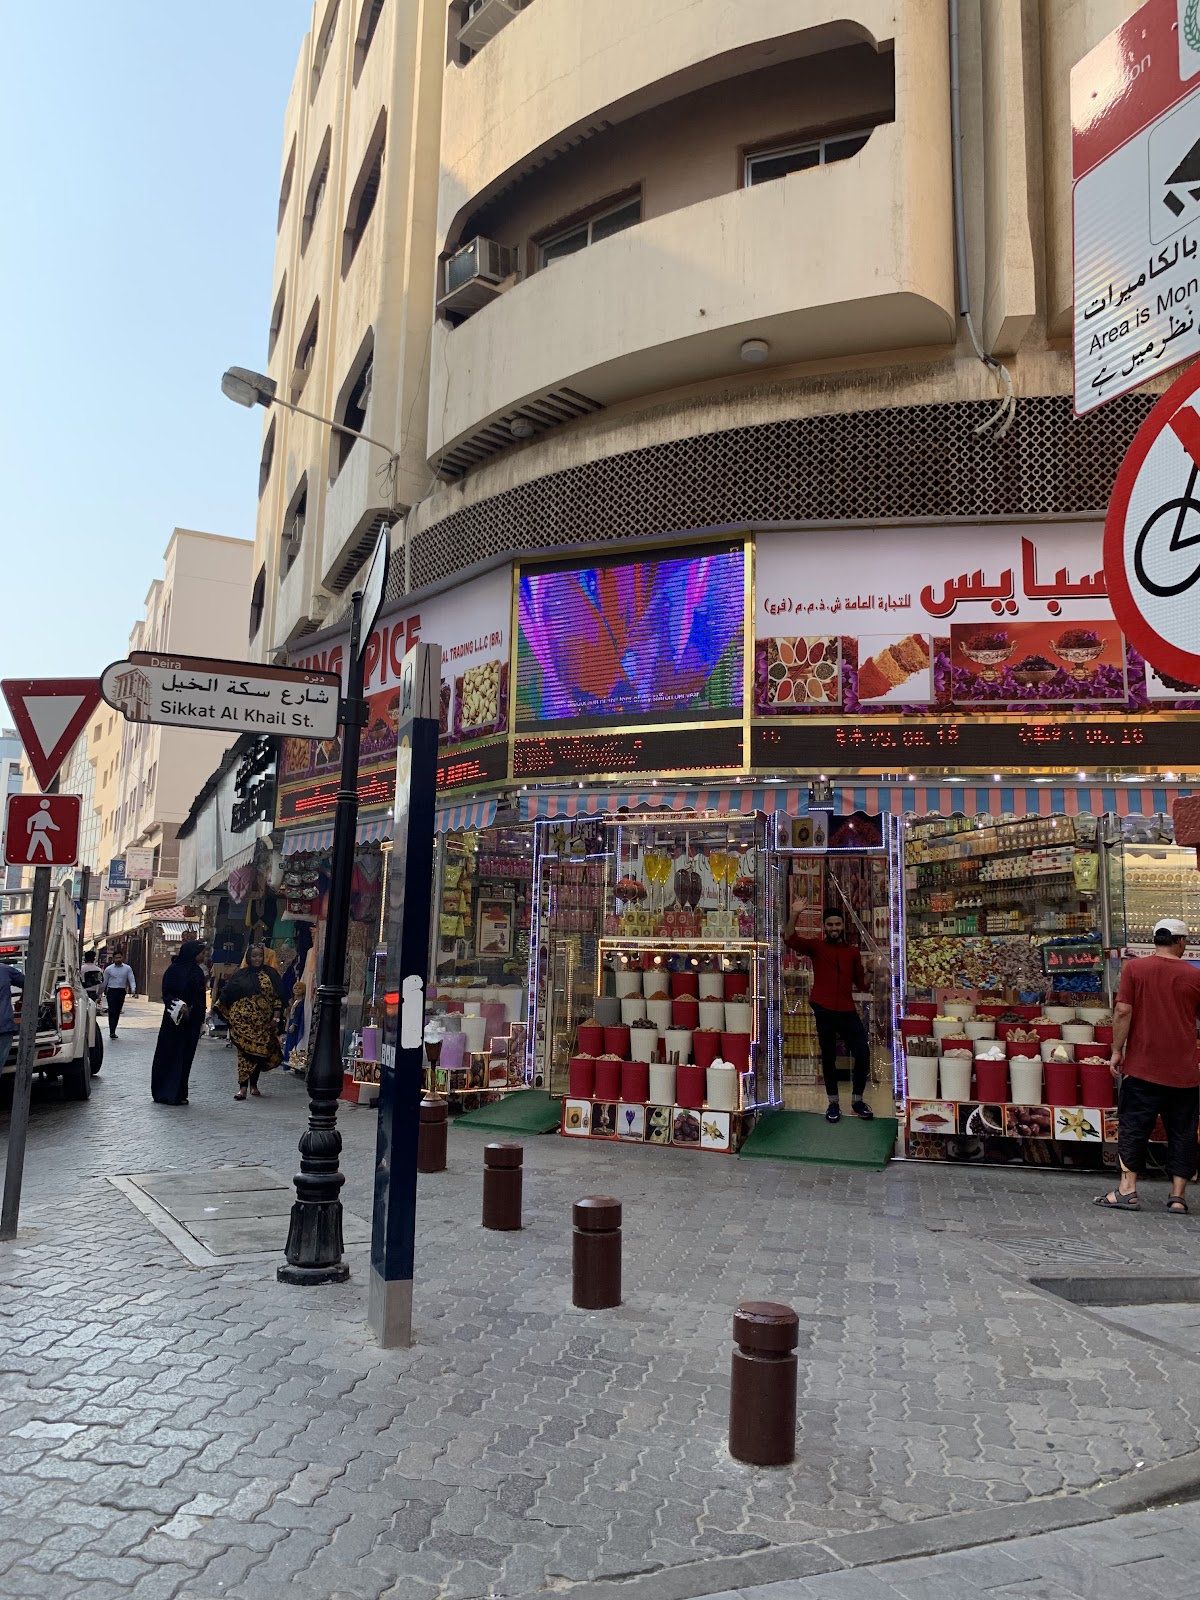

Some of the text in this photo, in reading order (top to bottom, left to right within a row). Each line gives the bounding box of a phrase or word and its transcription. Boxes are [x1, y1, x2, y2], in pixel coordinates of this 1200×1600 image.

[1084, 235, 1198, 320] بالكاميرات
[1089, 278, 1199, 356] Area is Mon
[845, 594, 875, 611] العامة
[878, 593, 911, 612] للتجارة
[150, 657, 182, 670] Deira
[450, 641, 474, 662] TRADING
[161, 674, 329, 706] شارع سكة الخيل
[160, 701, 314, 728] Sikkat Al Khail St.
